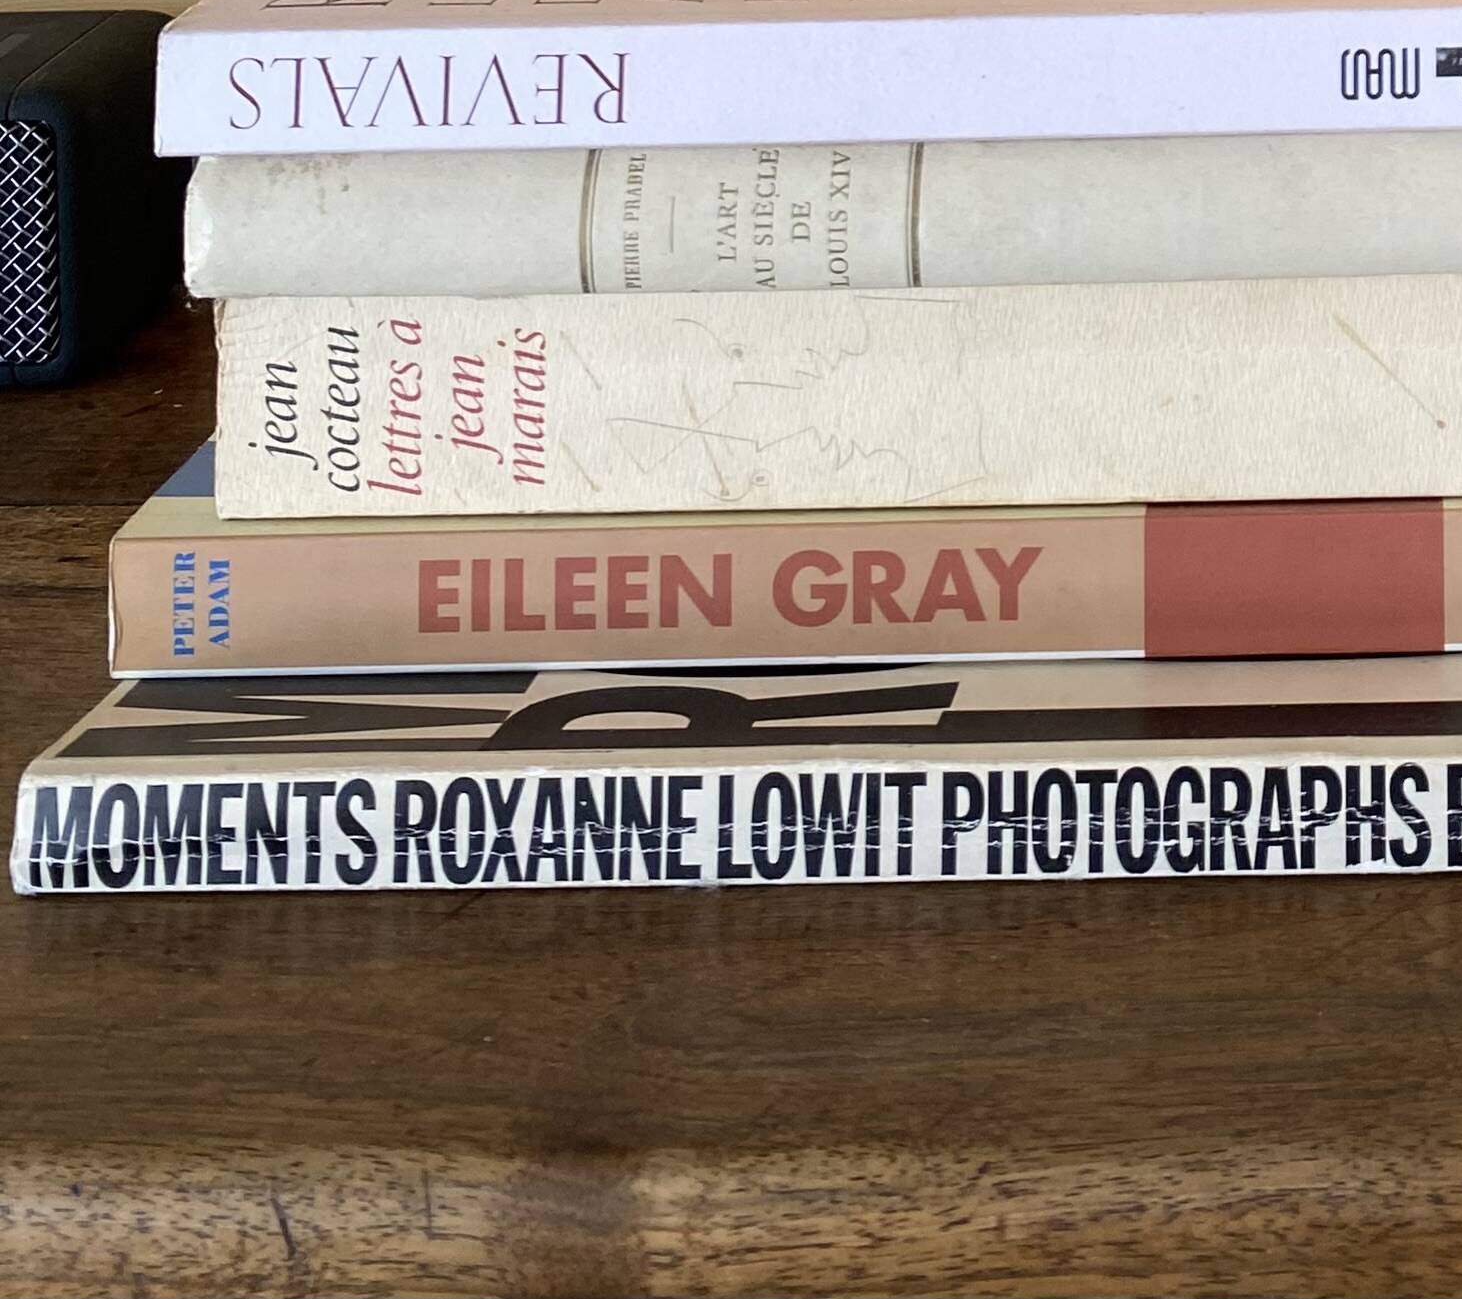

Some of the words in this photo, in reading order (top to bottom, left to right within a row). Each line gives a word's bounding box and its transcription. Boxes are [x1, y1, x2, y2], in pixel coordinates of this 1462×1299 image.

[228, 53, 631, 131] REVIVALS
[623, 152, 647, 222] PRADEL
[830, 150, 851, 200] XIV
[623, 229, 643, 289] PIERRE
[716, 182, 739, 262] L'ART
[790, 201, 812, 242] DE
[827, 209, 851, 288] LOUIS
[754, 258, 777, 289] AU
[376, 317, 423, 347] à
[248, 360, 319, 471] jean
[320, 325, 361, 493] cocteau
[366, 358, 423, 497] lettres
[435, 353, 504, 466] jean
[497, 327, 547, 486] marais
[172, 551, 197, 658] PETER
[207, 559, 231, 650] ADAM
[418, 552, 734, 634] EILEEN
[772, 545, 1045, 628] GRAY
[28, 777, 379, 889] MOMENTS
[392, 774, 703, 885] ROXANNE
[716, 770, 928, 881] LOWIT
[940, 762, 1431, 875] PHOTOGRAPHS
